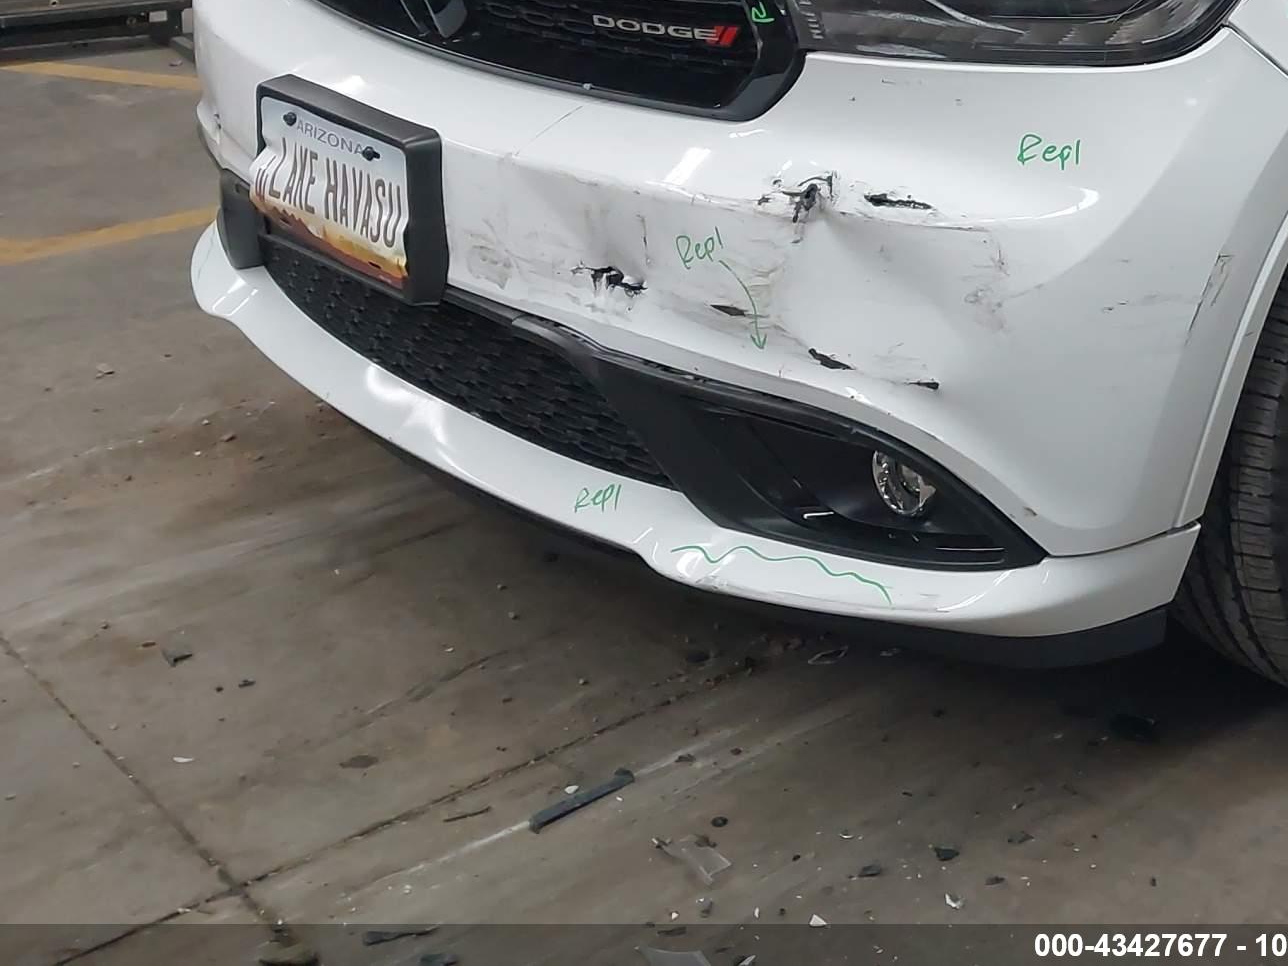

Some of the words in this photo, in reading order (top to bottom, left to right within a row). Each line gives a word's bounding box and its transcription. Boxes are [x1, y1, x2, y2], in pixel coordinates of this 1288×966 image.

[592, 14, 721, 41] DODGE
[296, 119, 364, 155] ARIZONA
[324, 157, 402, 248] HAVASU
